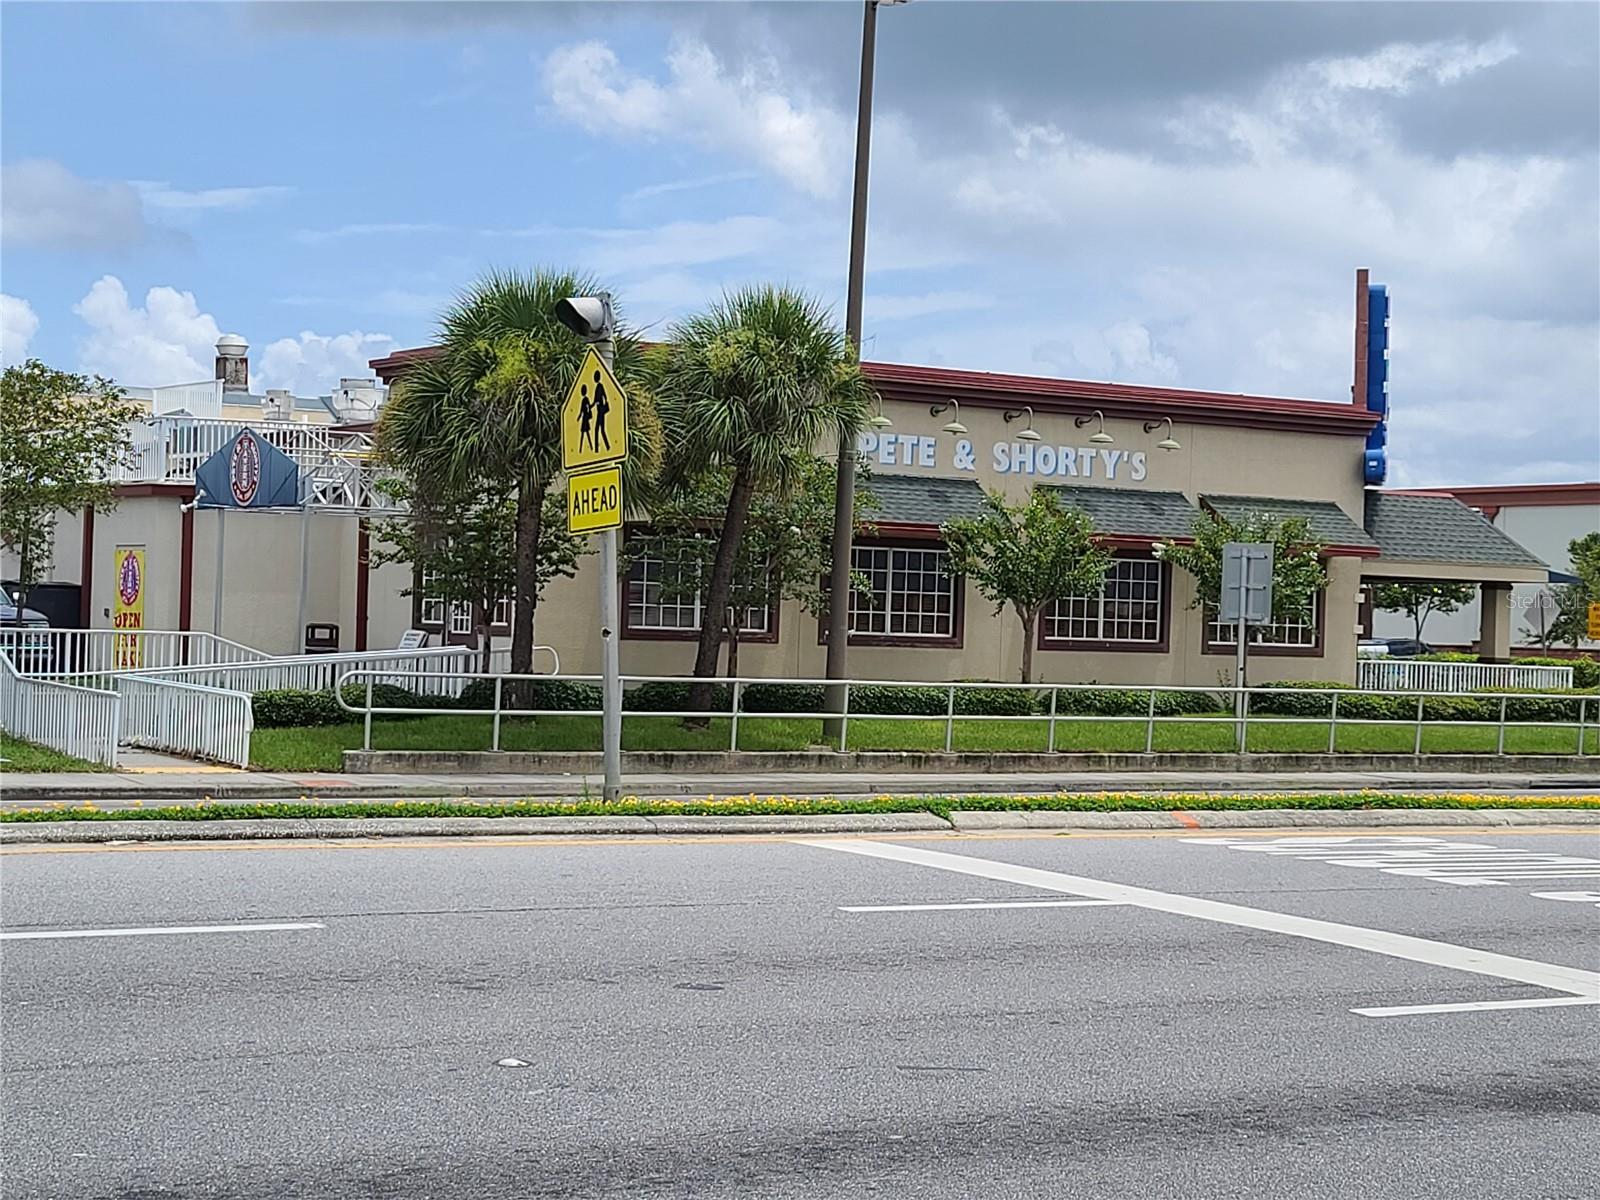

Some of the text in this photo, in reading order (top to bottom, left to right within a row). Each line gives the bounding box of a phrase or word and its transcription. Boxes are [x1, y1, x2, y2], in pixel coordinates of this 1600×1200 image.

[858, 432, 1148, 481] PETE & SHORTY'S
[573, 485, 617, 516] AHEAD
[114, 612, 141, 628] OPEN
